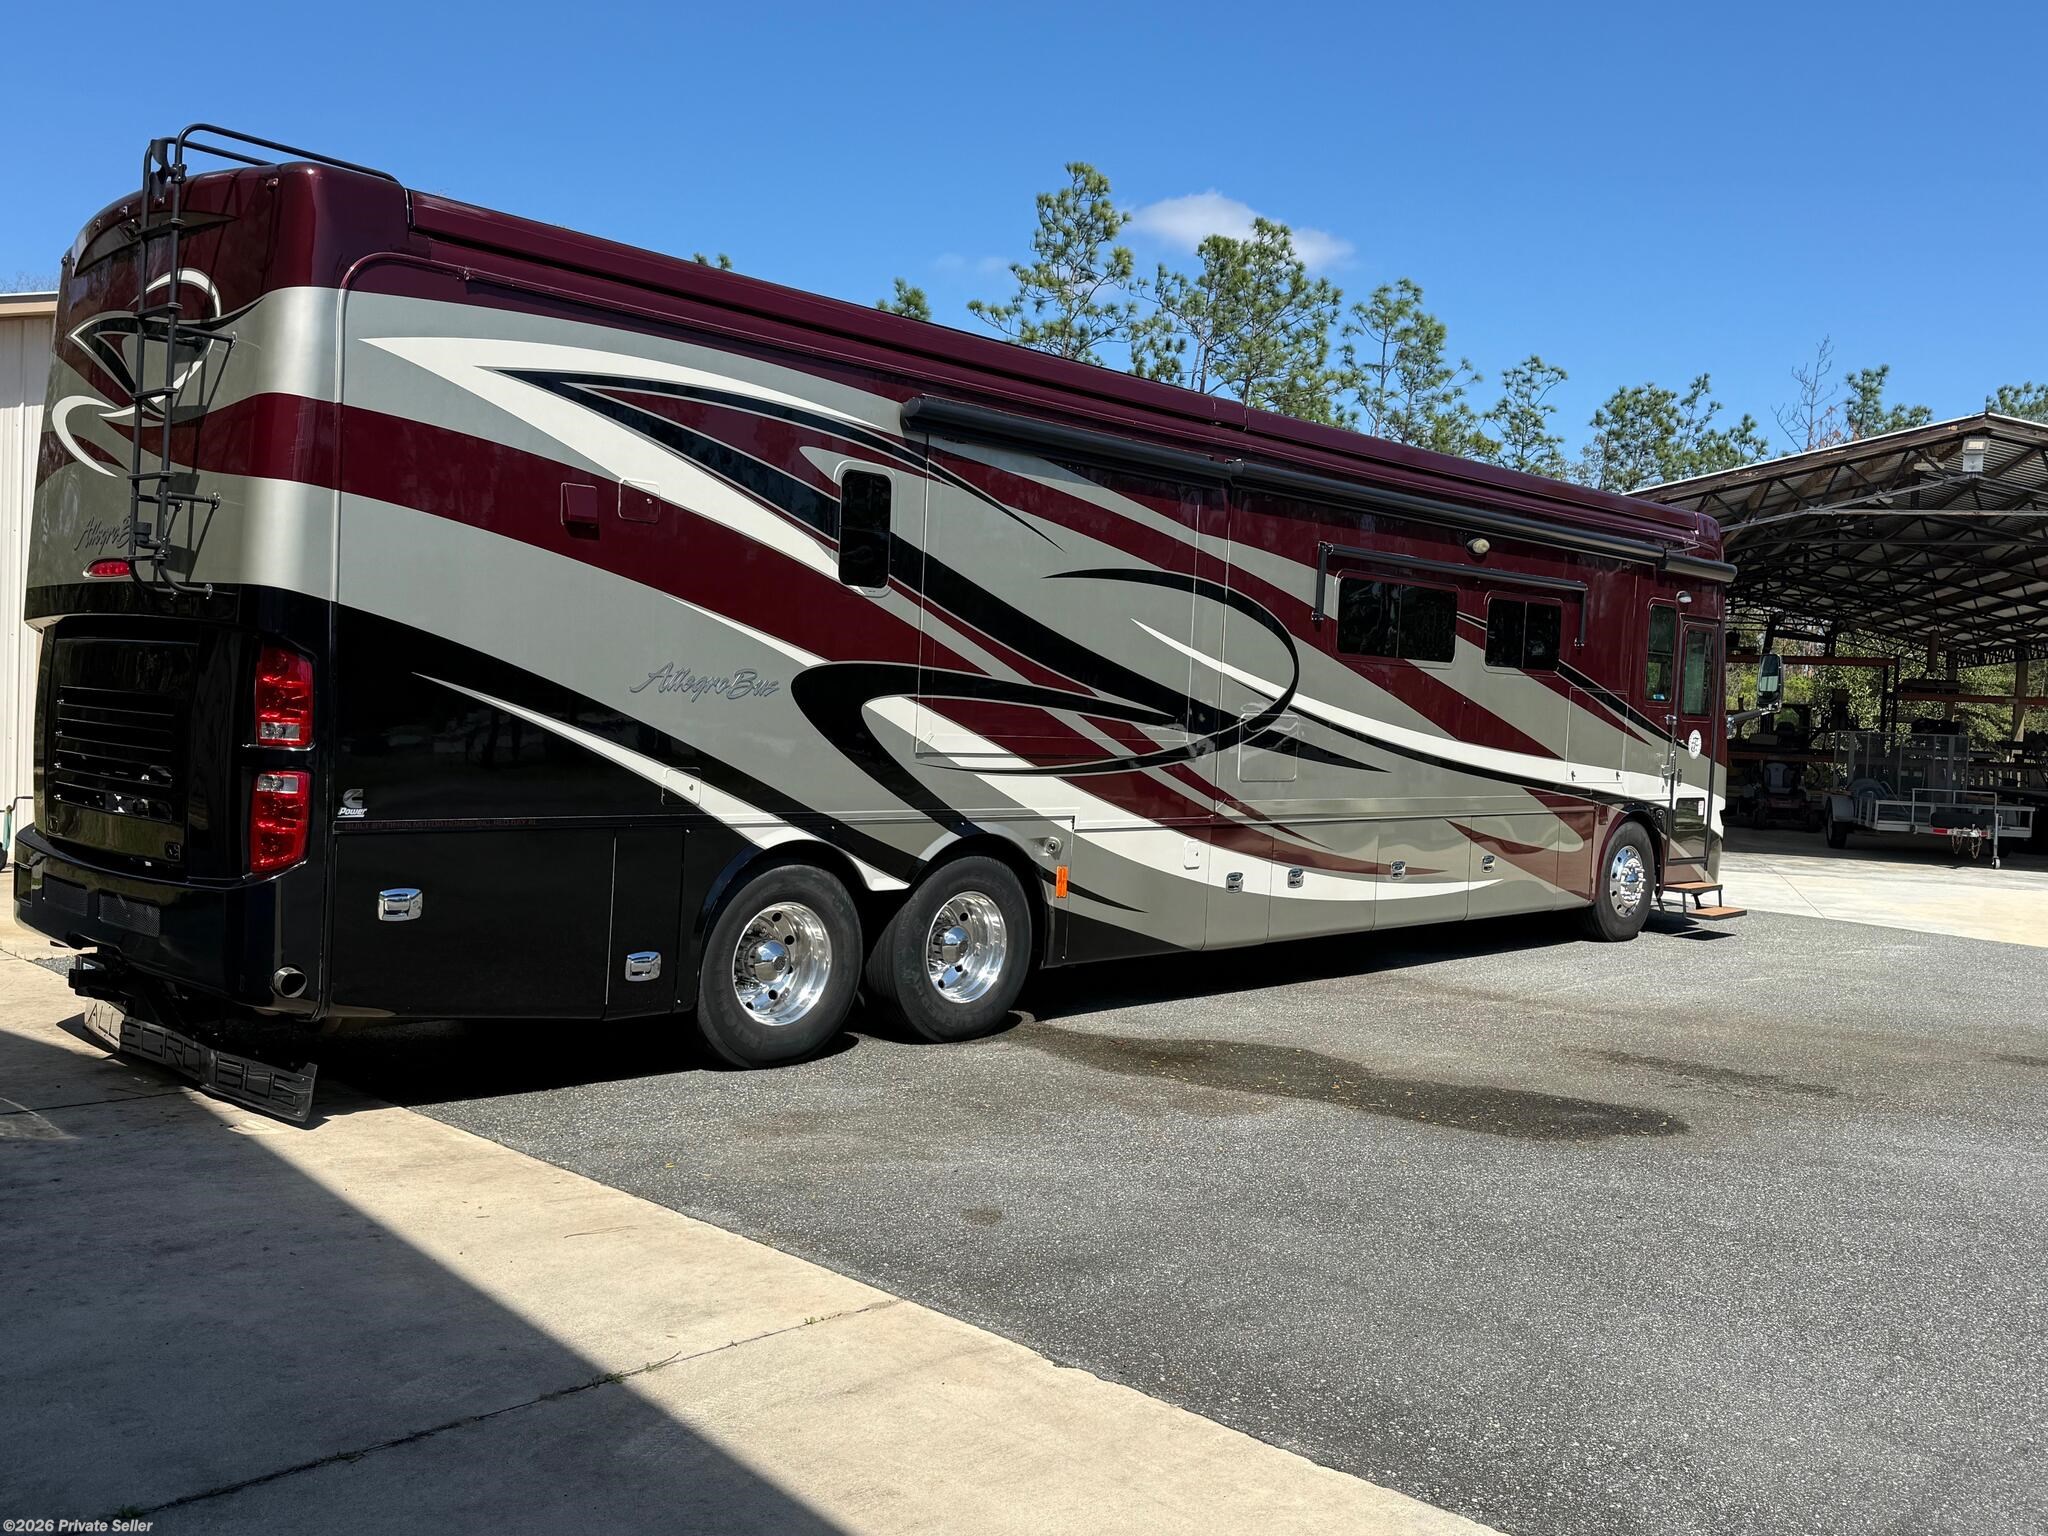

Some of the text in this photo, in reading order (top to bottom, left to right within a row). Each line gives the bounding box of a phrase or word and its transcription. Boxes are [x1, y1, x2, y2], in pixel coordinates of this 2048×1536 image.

[338, 807, 368, 816] Power
[86, 1001, 297, 1107] ALLEGRO BUS
